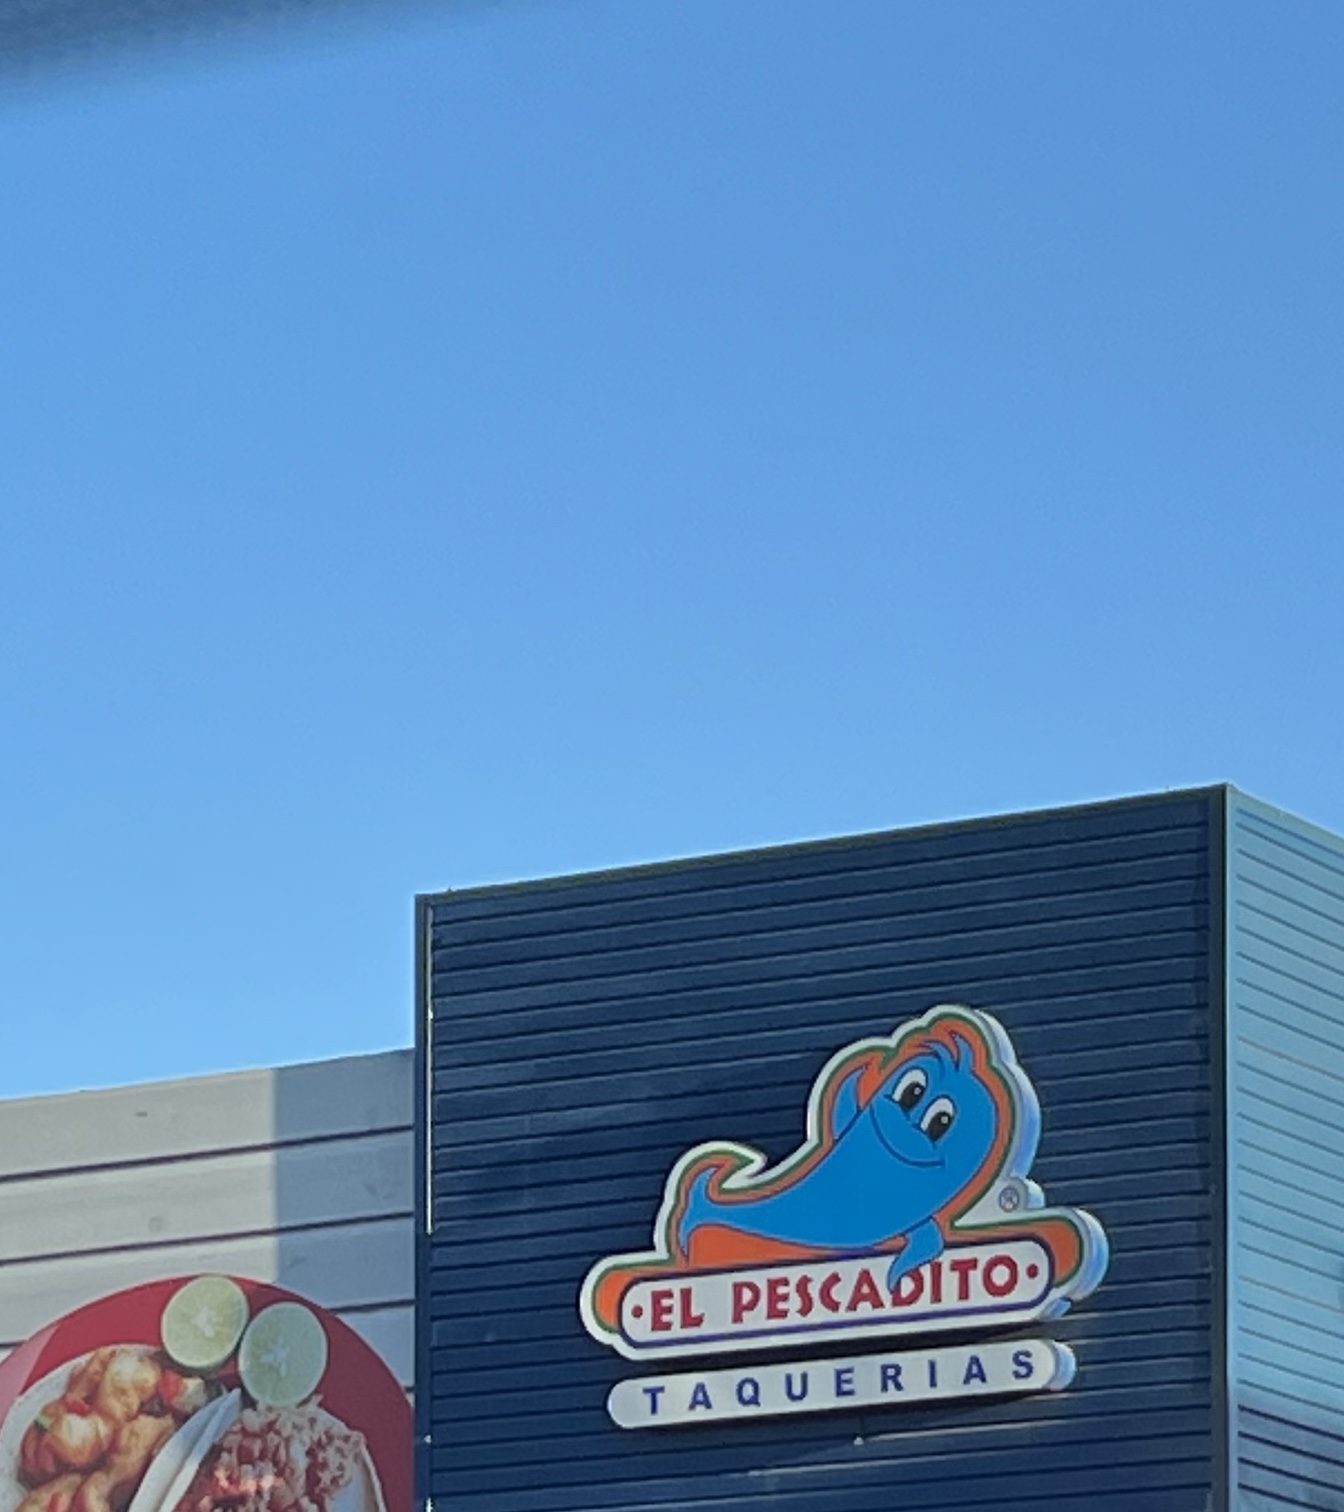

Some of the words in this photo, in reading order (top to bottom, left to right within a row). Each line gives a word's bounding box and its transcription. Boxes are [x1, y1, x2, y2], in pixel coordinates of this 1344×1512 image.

[650, 1287, 704, 1332] EL
[731, 1254, 1019, 1324] PESCADITO
[642, 1349, 1034, 1416] TAQUERIAS
